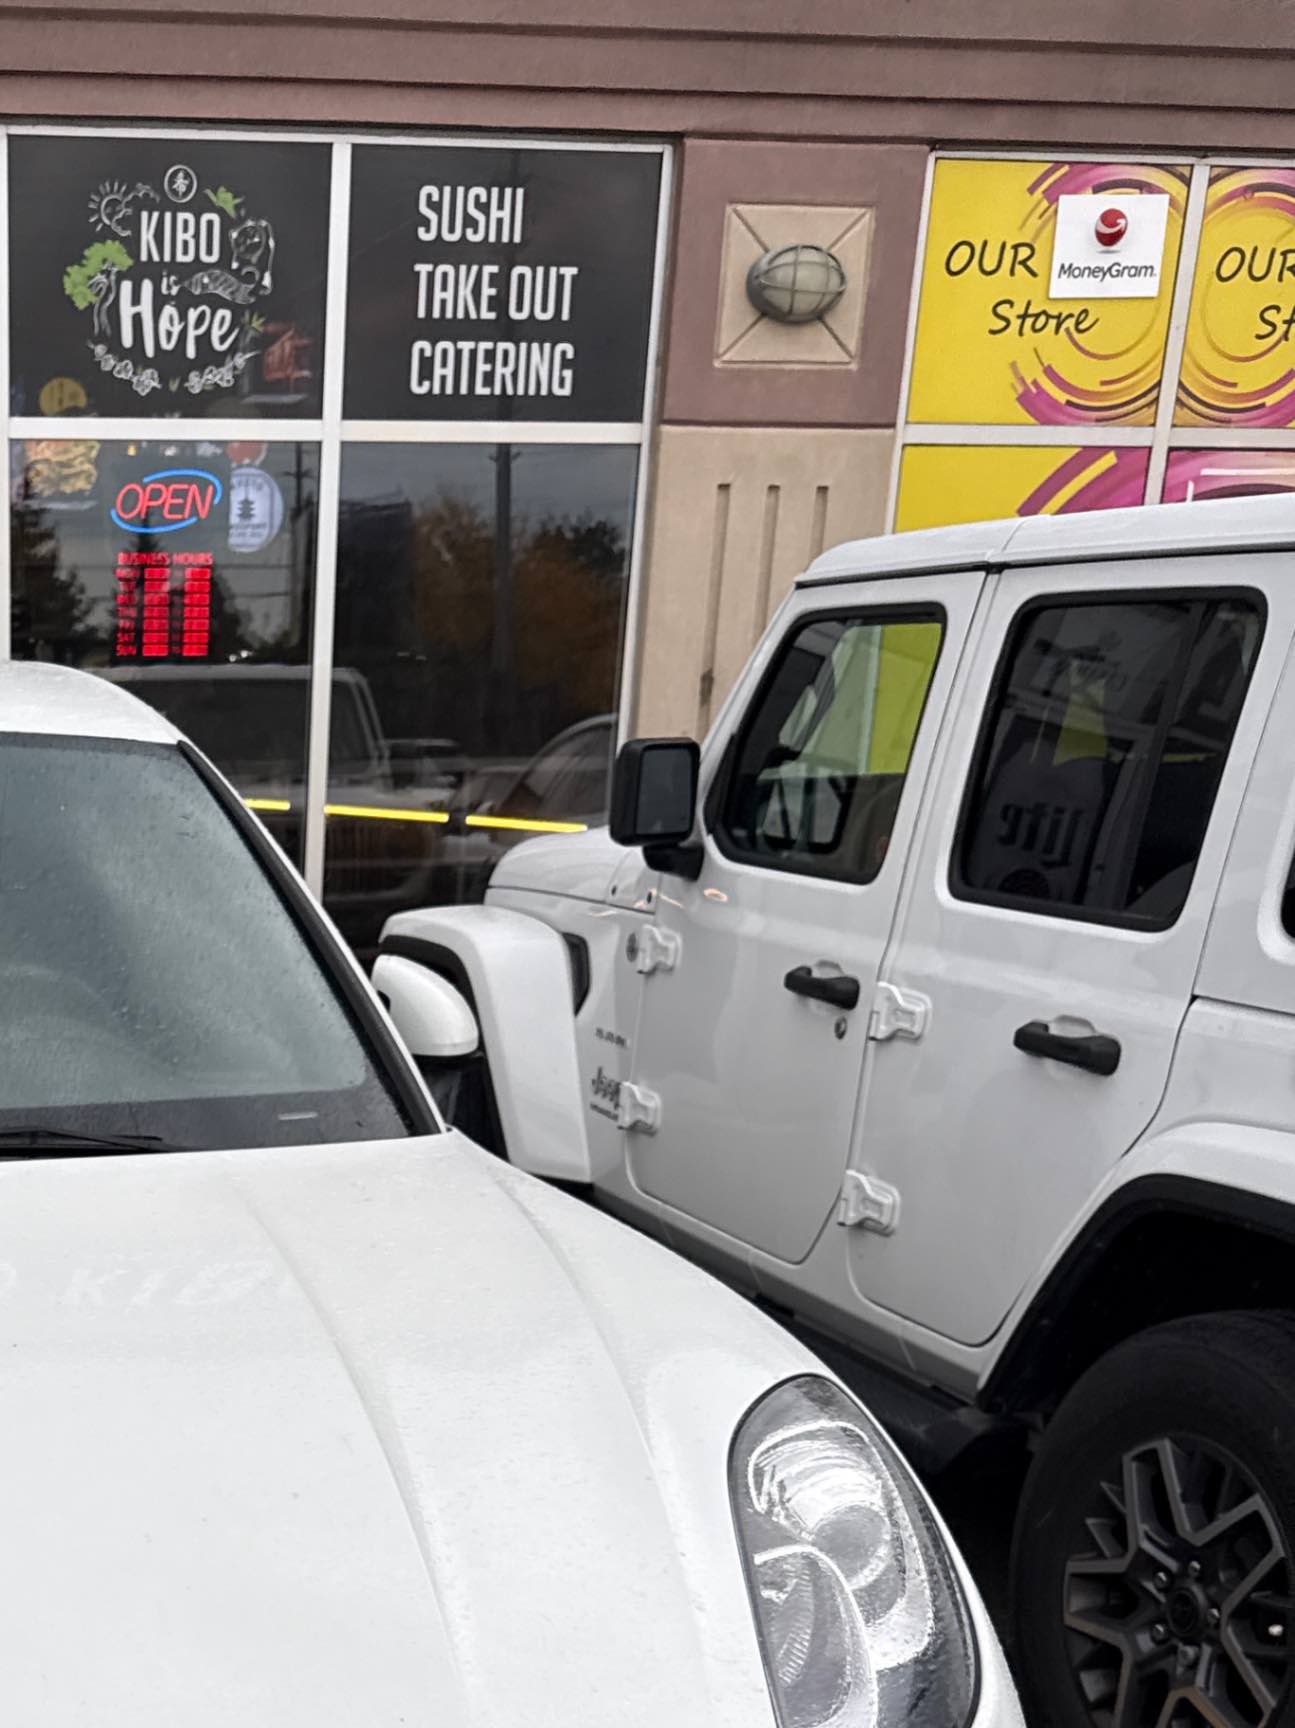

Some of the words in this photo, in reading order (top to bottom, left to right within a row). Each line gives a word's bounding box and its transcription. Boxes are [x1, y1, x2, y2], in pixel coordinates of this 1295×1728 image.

[139, 210, 221, 263] KIBO
[417, 185, 524, 243] SUSHI
[160, 269, 180, 296] is
[944, 239, 1039, 278] OUR
[118, 278, 240, 359] Hope
[413, 263, 500, 319] TAKE
[508, 265, 579, 321] OUT
[988, 299, 1100, 337] Store
[410, 340, 575, 396] CATERING
[115, 483, 214, 519] OPEN
